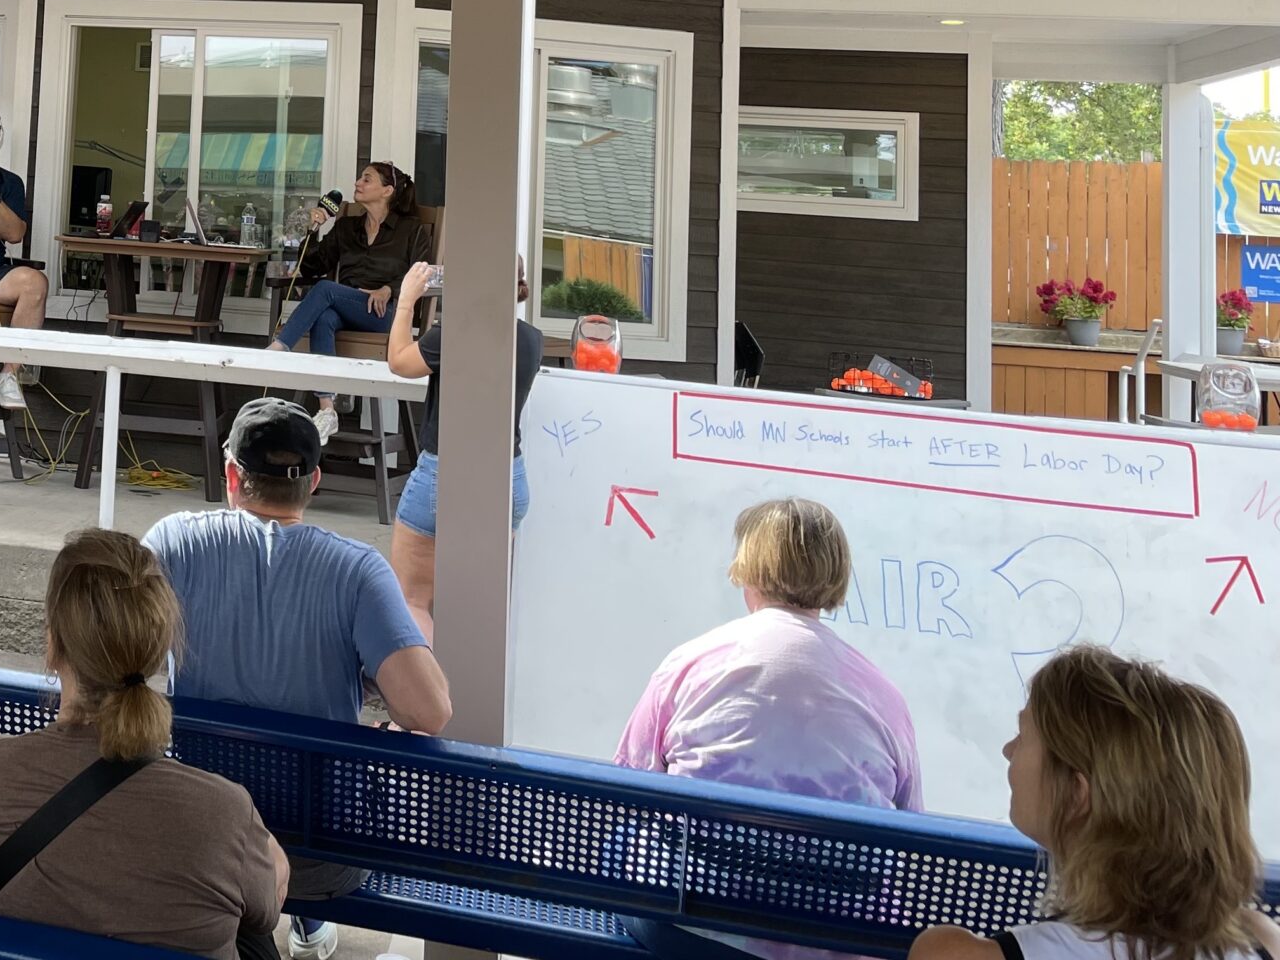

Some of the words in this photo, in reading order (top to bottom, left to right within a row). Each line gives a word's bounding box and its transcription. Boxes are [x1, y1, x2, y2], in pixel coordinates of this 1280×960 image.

[1246, 252, 1280, 271] WA
[542, 410, 602, 457] YES
[687, 409, 745, 440] Should
[762, 421, 787, 443] MN
[794, 424, 850, 446] Schools
[928, 436, 1001, 458] AFTER
[1023, 443, 1089, 471] Labor
[1101, 454, 1165, 488] Day?
